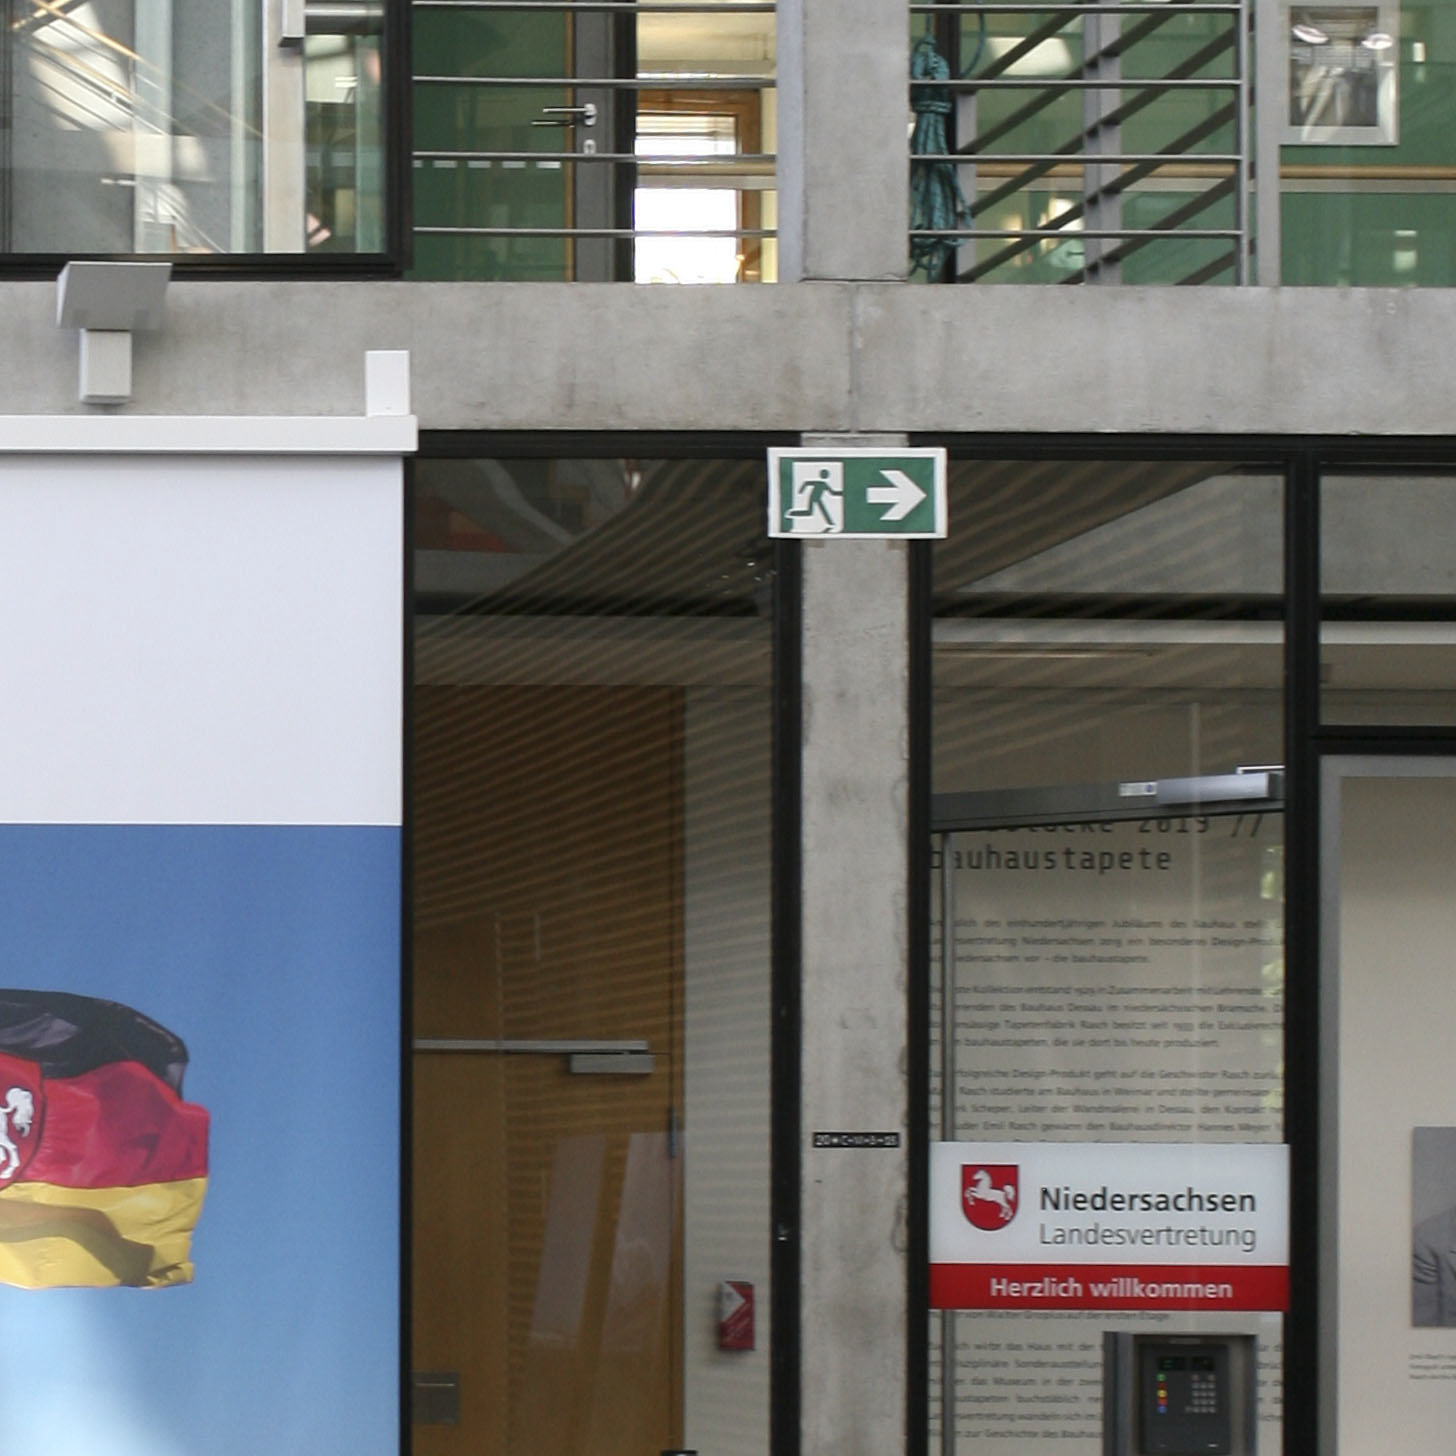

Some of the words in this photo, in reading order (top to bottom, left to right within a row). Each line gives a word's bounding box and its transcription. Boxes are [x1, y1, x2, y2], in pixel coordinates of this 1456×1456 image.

[1040, 1187, 1255, 1213] Niedersachsen
[1040, 1223, 1256, 1252] Landesvertretung
[990, 1278, 1082, 1300] Herzlich
[1090, 1278, 1232, 1300] willkommen
